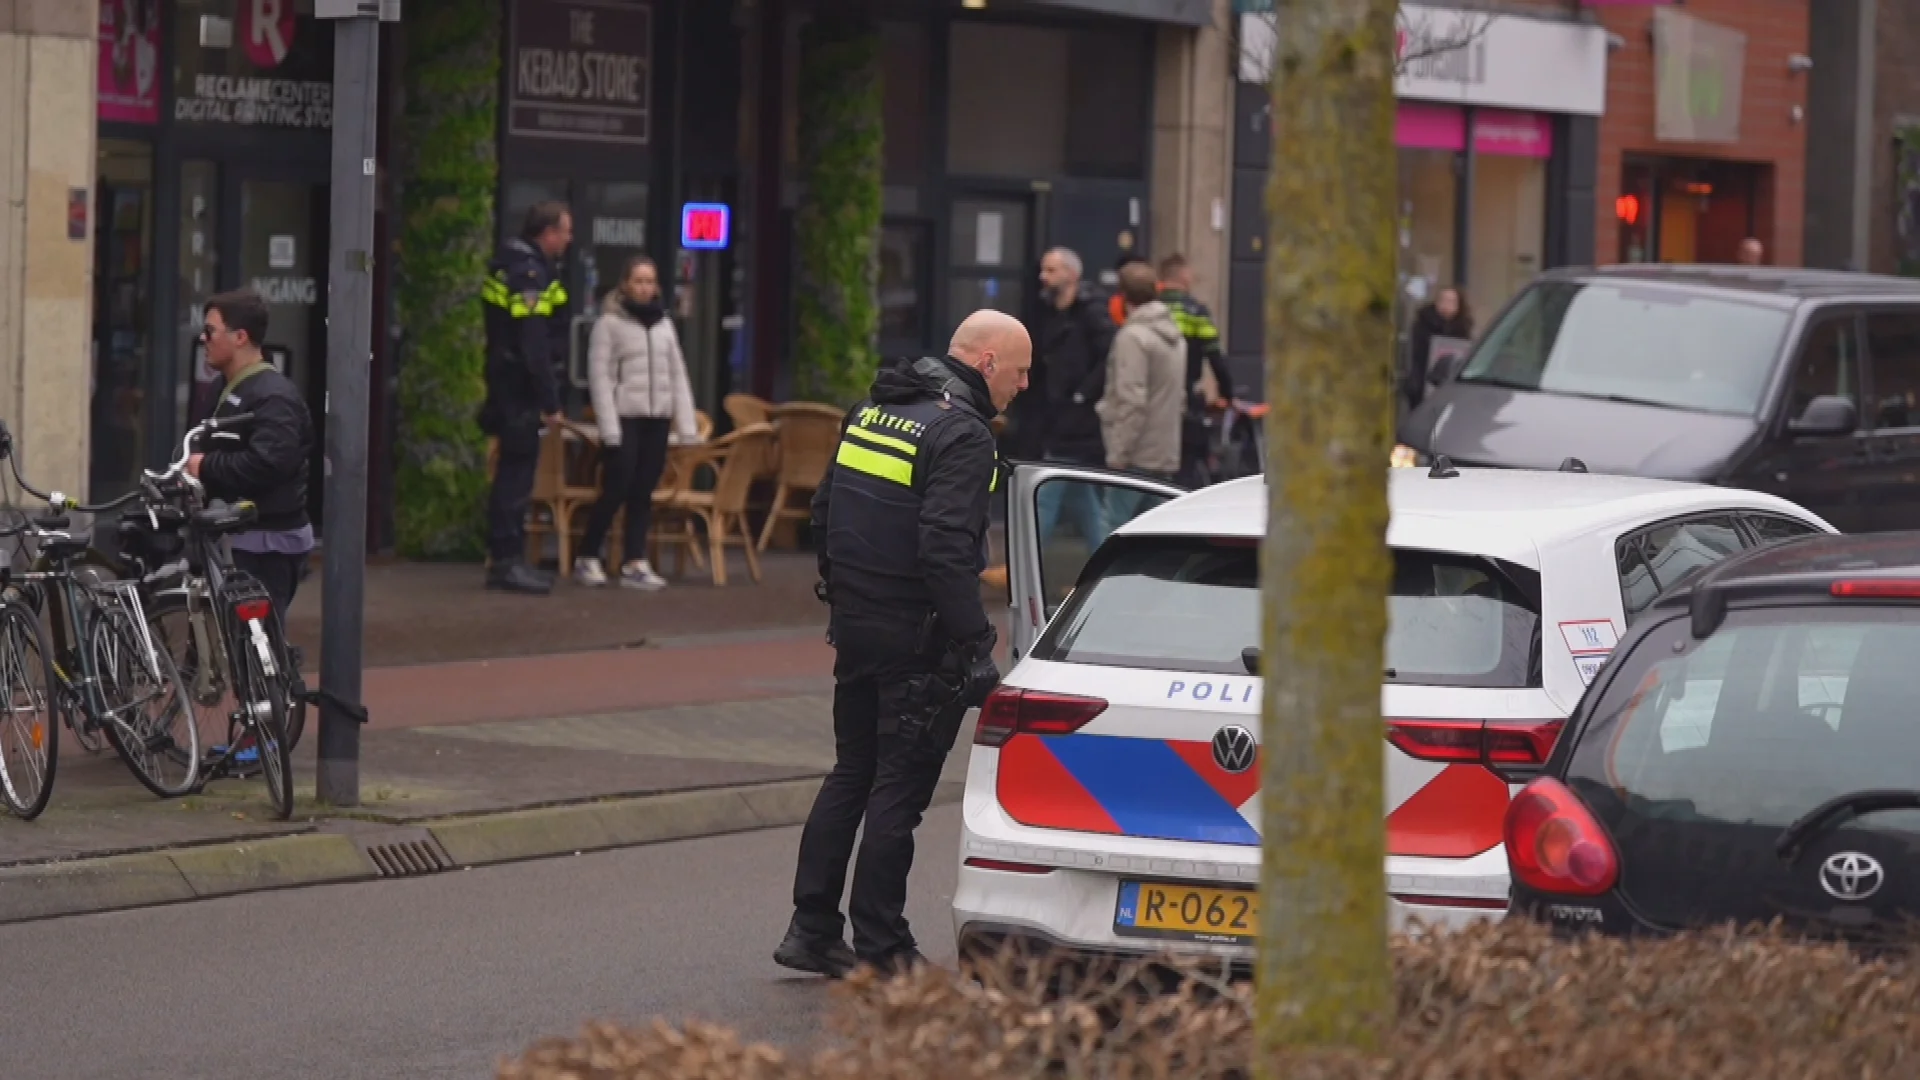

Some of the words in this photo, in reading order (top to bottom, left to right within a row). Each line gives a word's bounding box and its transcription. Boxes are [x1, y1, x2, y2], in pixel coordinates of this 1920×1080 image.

[569, 10, 595, 44] THE
[195, 74, 332, 105] RECLAMECENTER
[518, 49, 577, 97] KEBAB
[583, 55, 640, 102] STORE
[174, 97, 231, 121] DIGITAL
[304, 105, 332, 128] STO
[1167, 680, 1254, 703] POLI
[1120, 907, 1133, 919] NL
[1145, 889, 1259, 929] R-062-
[1551, 904, 1603, 923] TOYOTA
